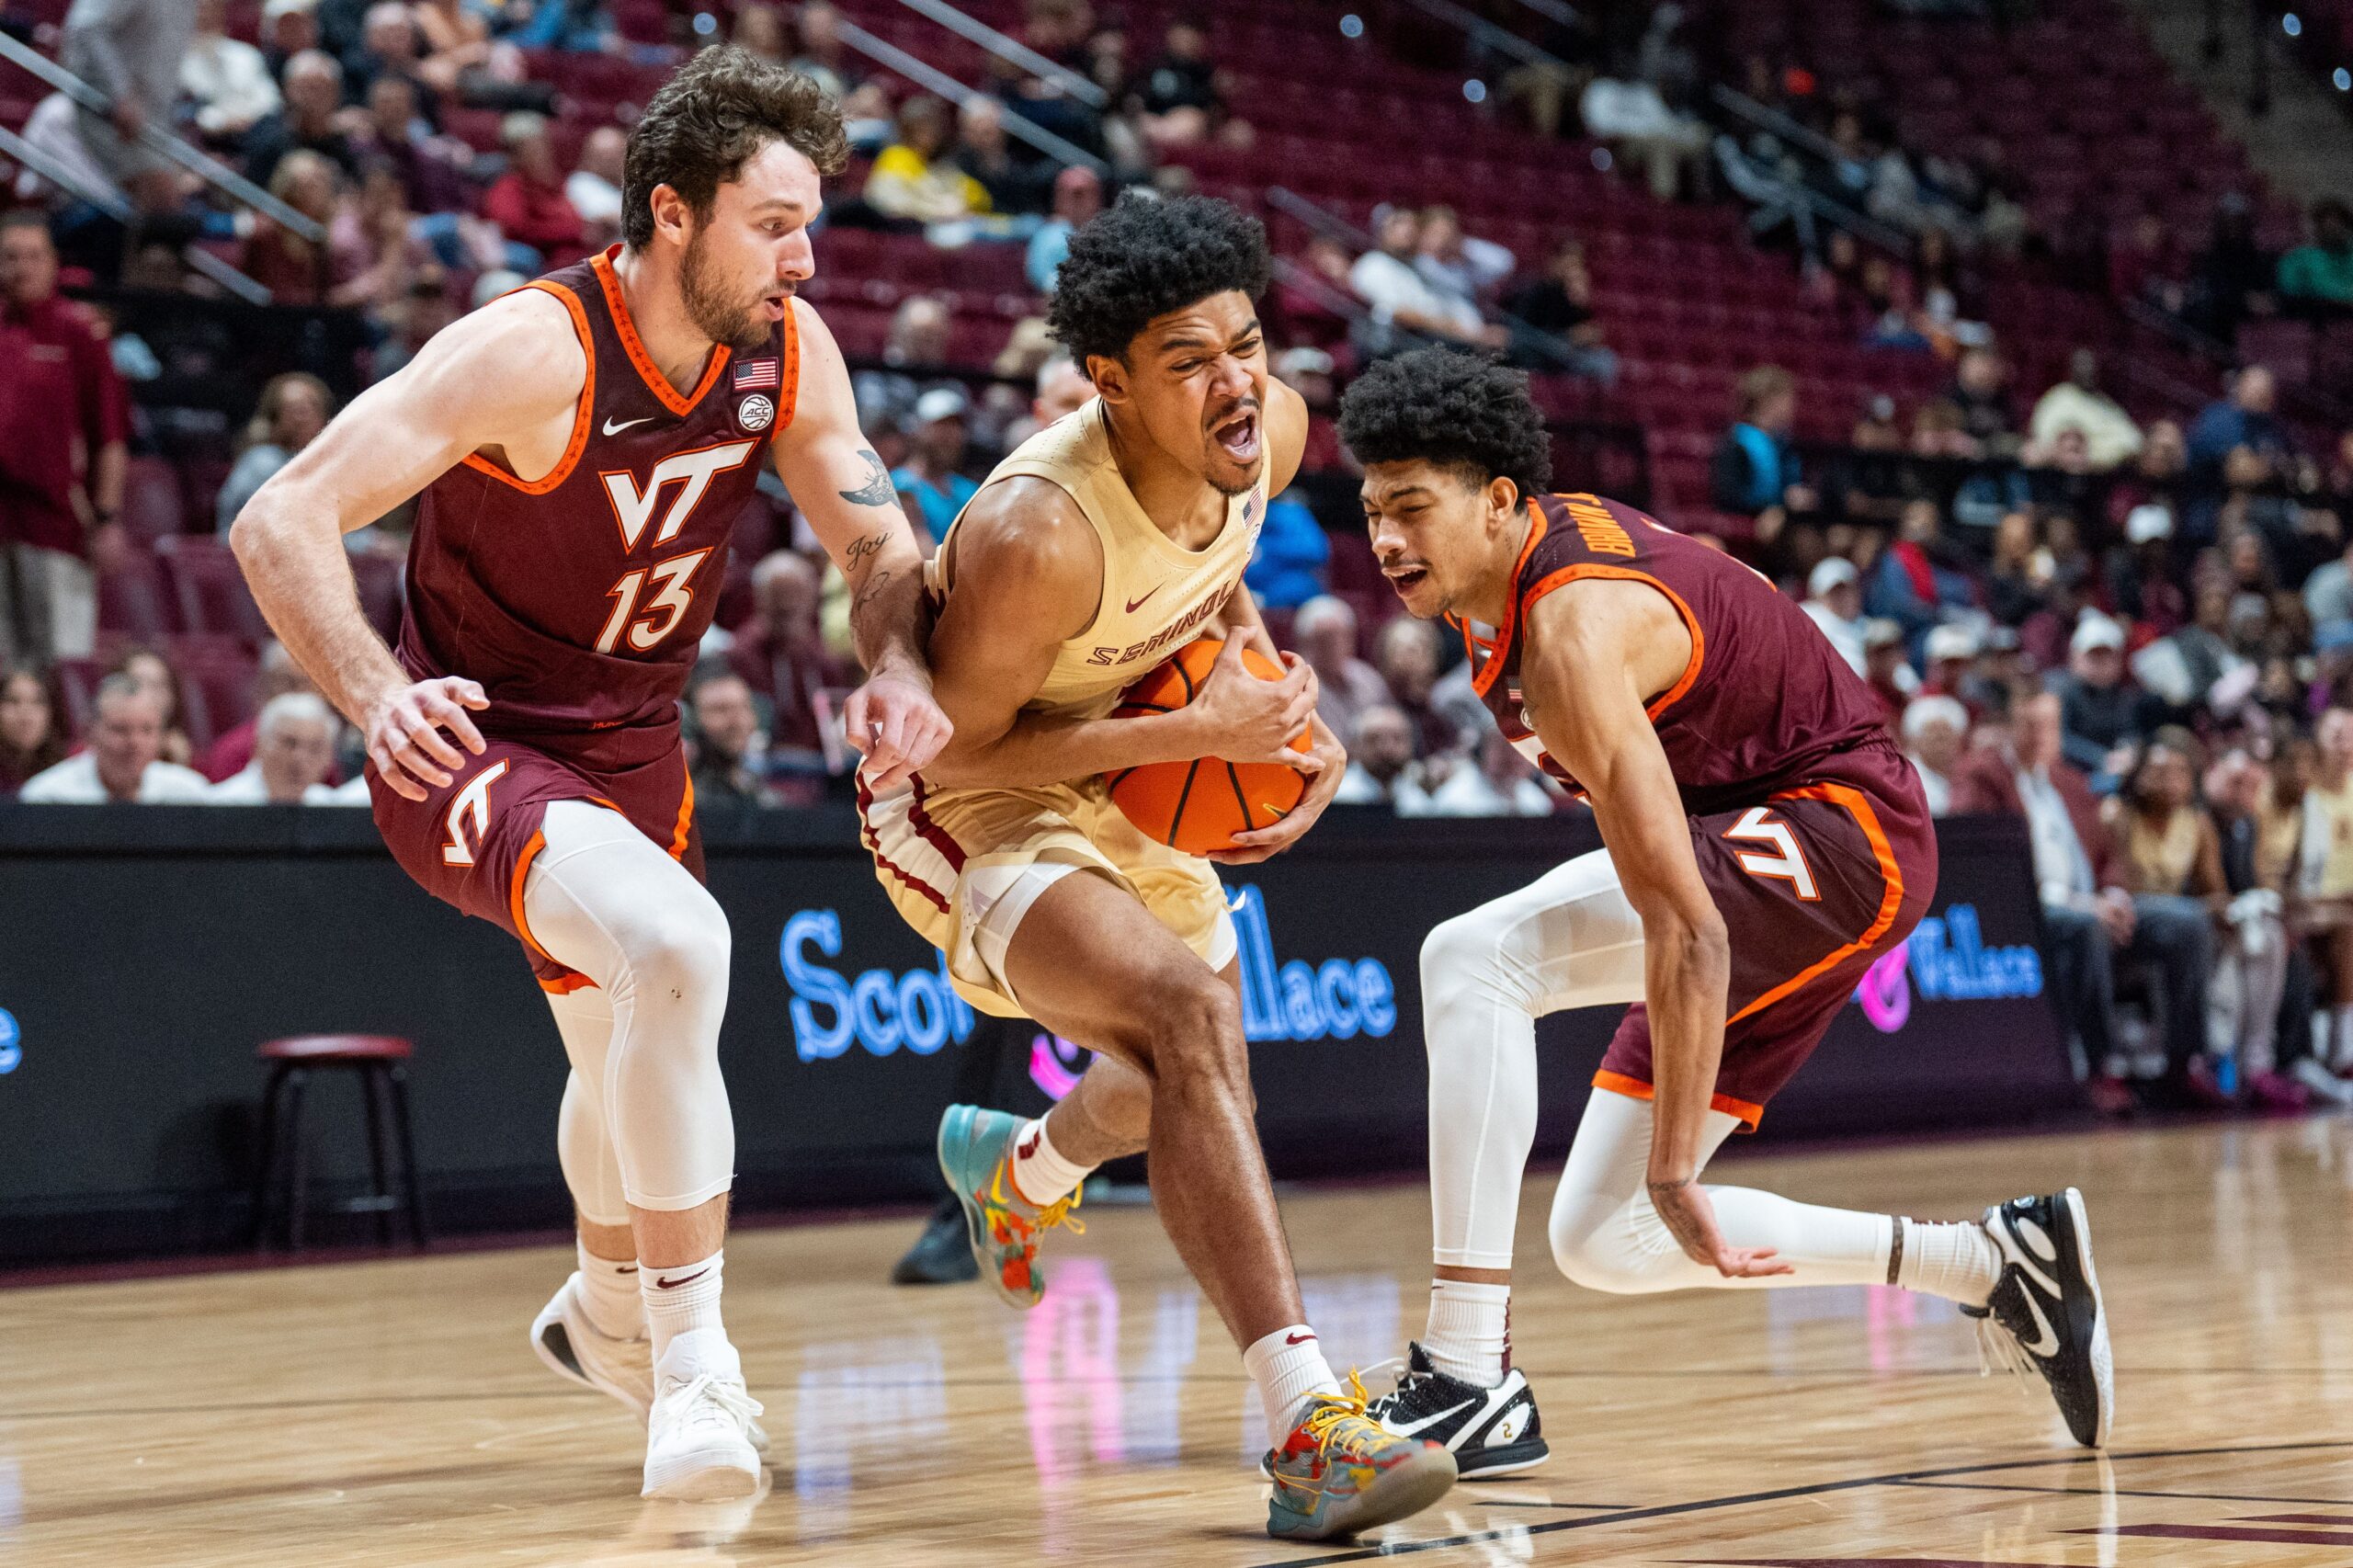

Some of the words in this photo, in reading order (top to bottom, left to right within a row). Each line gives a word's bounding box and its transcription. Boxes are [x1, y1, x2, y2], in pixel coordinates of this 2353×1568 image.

[745, 406, 771, 415] ACC
[598, 437, 762, 555] VT
[846, 532, 894, 572] Joy
[593, 547, 714, 656] 13
[1086, 579, 1233, 666] SEMINOL
[1722, 805, 1823, 903] VT
